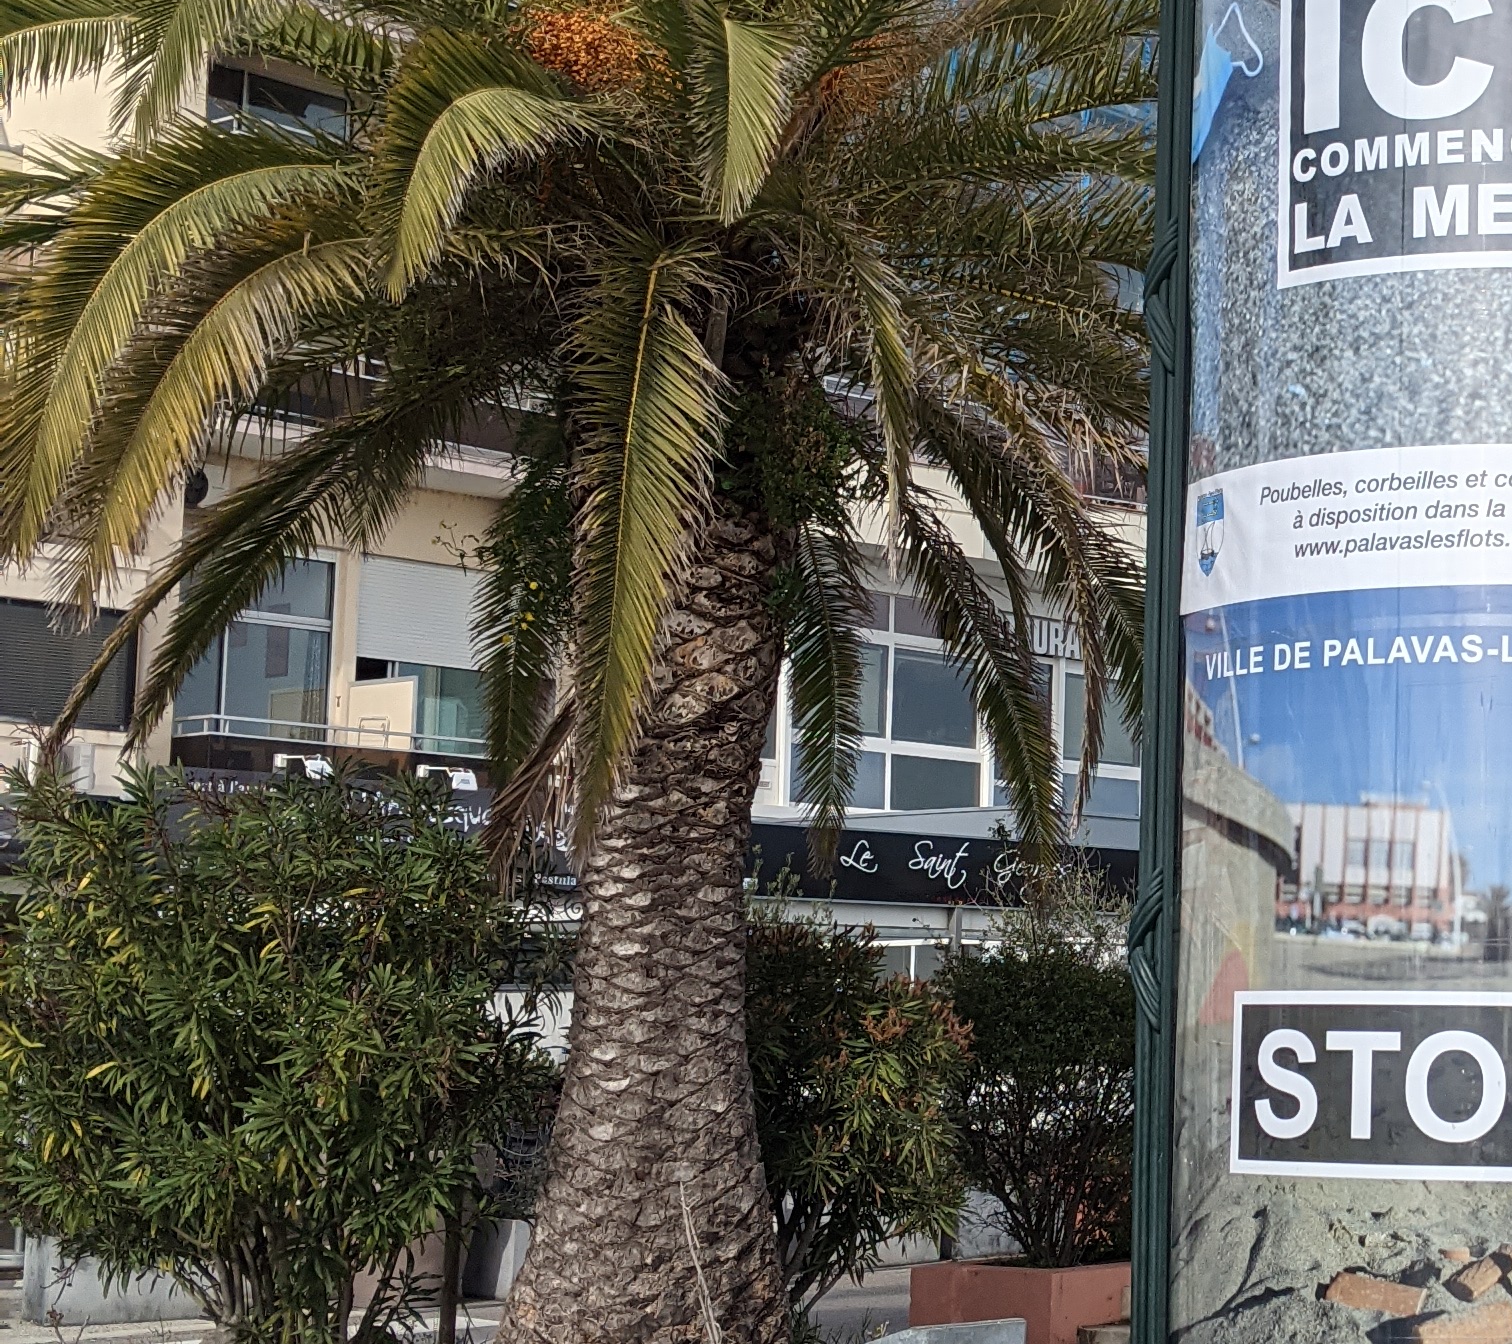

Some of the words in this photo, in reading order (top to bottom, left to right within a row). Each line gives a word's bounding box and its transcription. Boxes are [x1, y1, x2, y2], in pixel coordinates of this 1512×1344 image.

[1292, 192, 1374, 255] LA
[1259, 478, 1348, 506] Poubelles,
[1354, 470, 1459, 495] corbeilles
[1465, 469, 1488, 488] et
[1292, 509, 1304, 530] à
[1308, 501, 1418, 530] disposition
[1424, 499, 1480, 520] dans
[1485, 498, 1506, 518] la
[1205, 645, 1264, 681] VILLE
[1273, 641, 1311, 671] DE
[839, 839, 878, 873] Le
[908, 840, 970, 889] Saint
